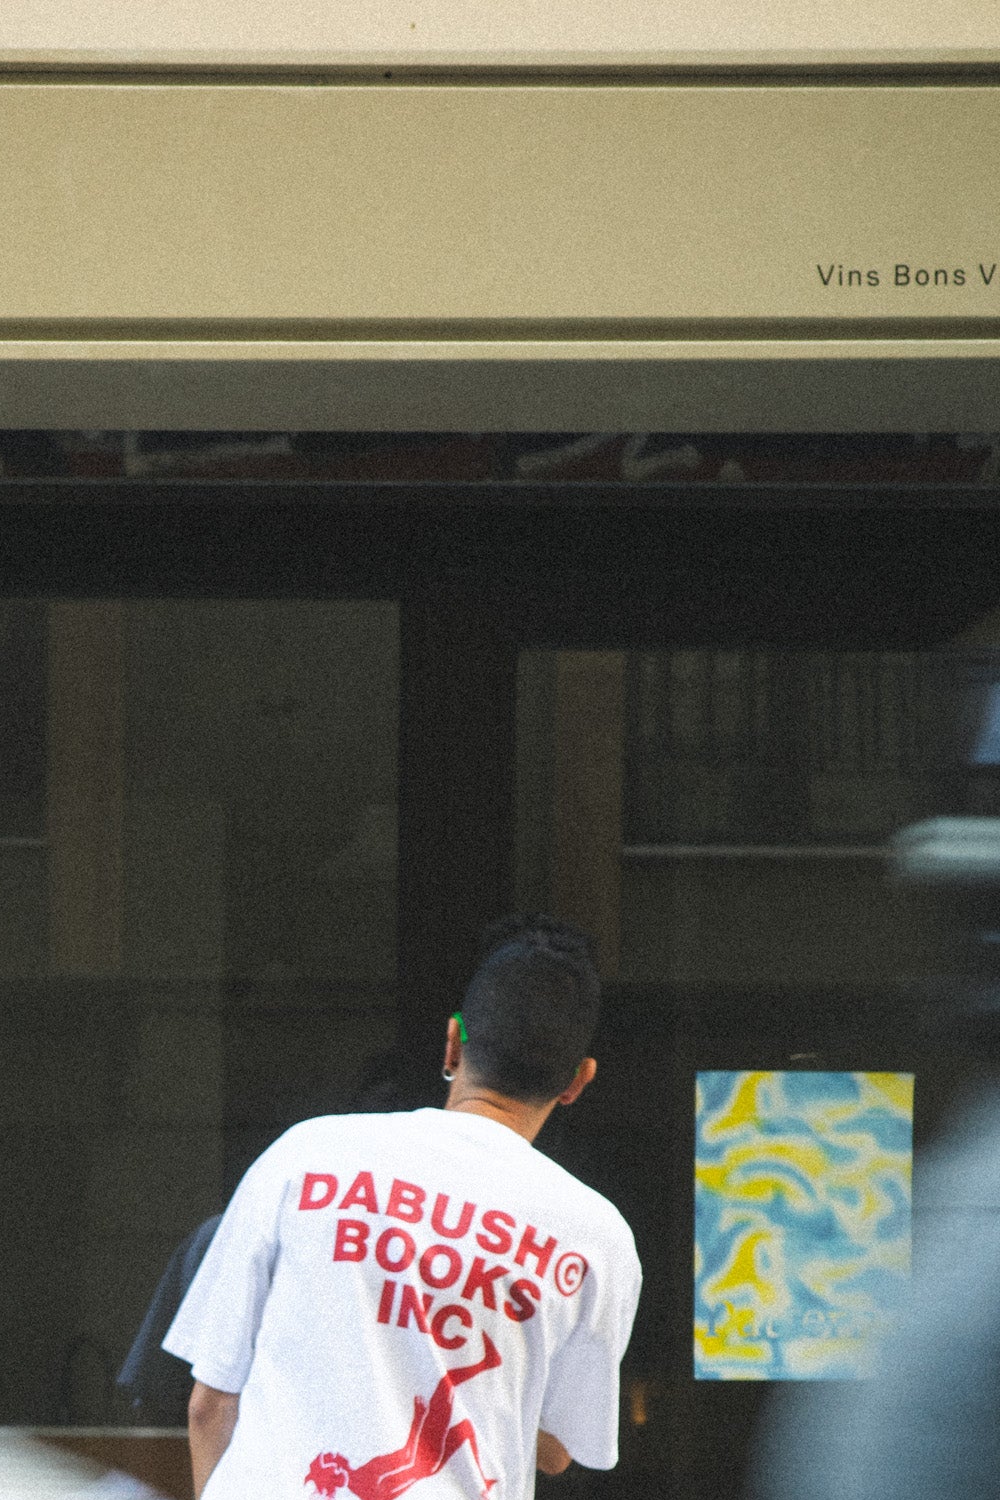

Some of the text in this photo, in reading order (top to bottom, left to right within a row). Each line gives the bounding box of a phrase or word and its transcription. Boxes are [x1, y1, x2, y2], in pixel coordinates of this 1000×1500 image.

[816, 263, 880, 287] Vins
[894, 262, 967, 287] Bons
[333, 1218, 542, 1322] BOOKS
[376, 1279, 473, 1350] INC
